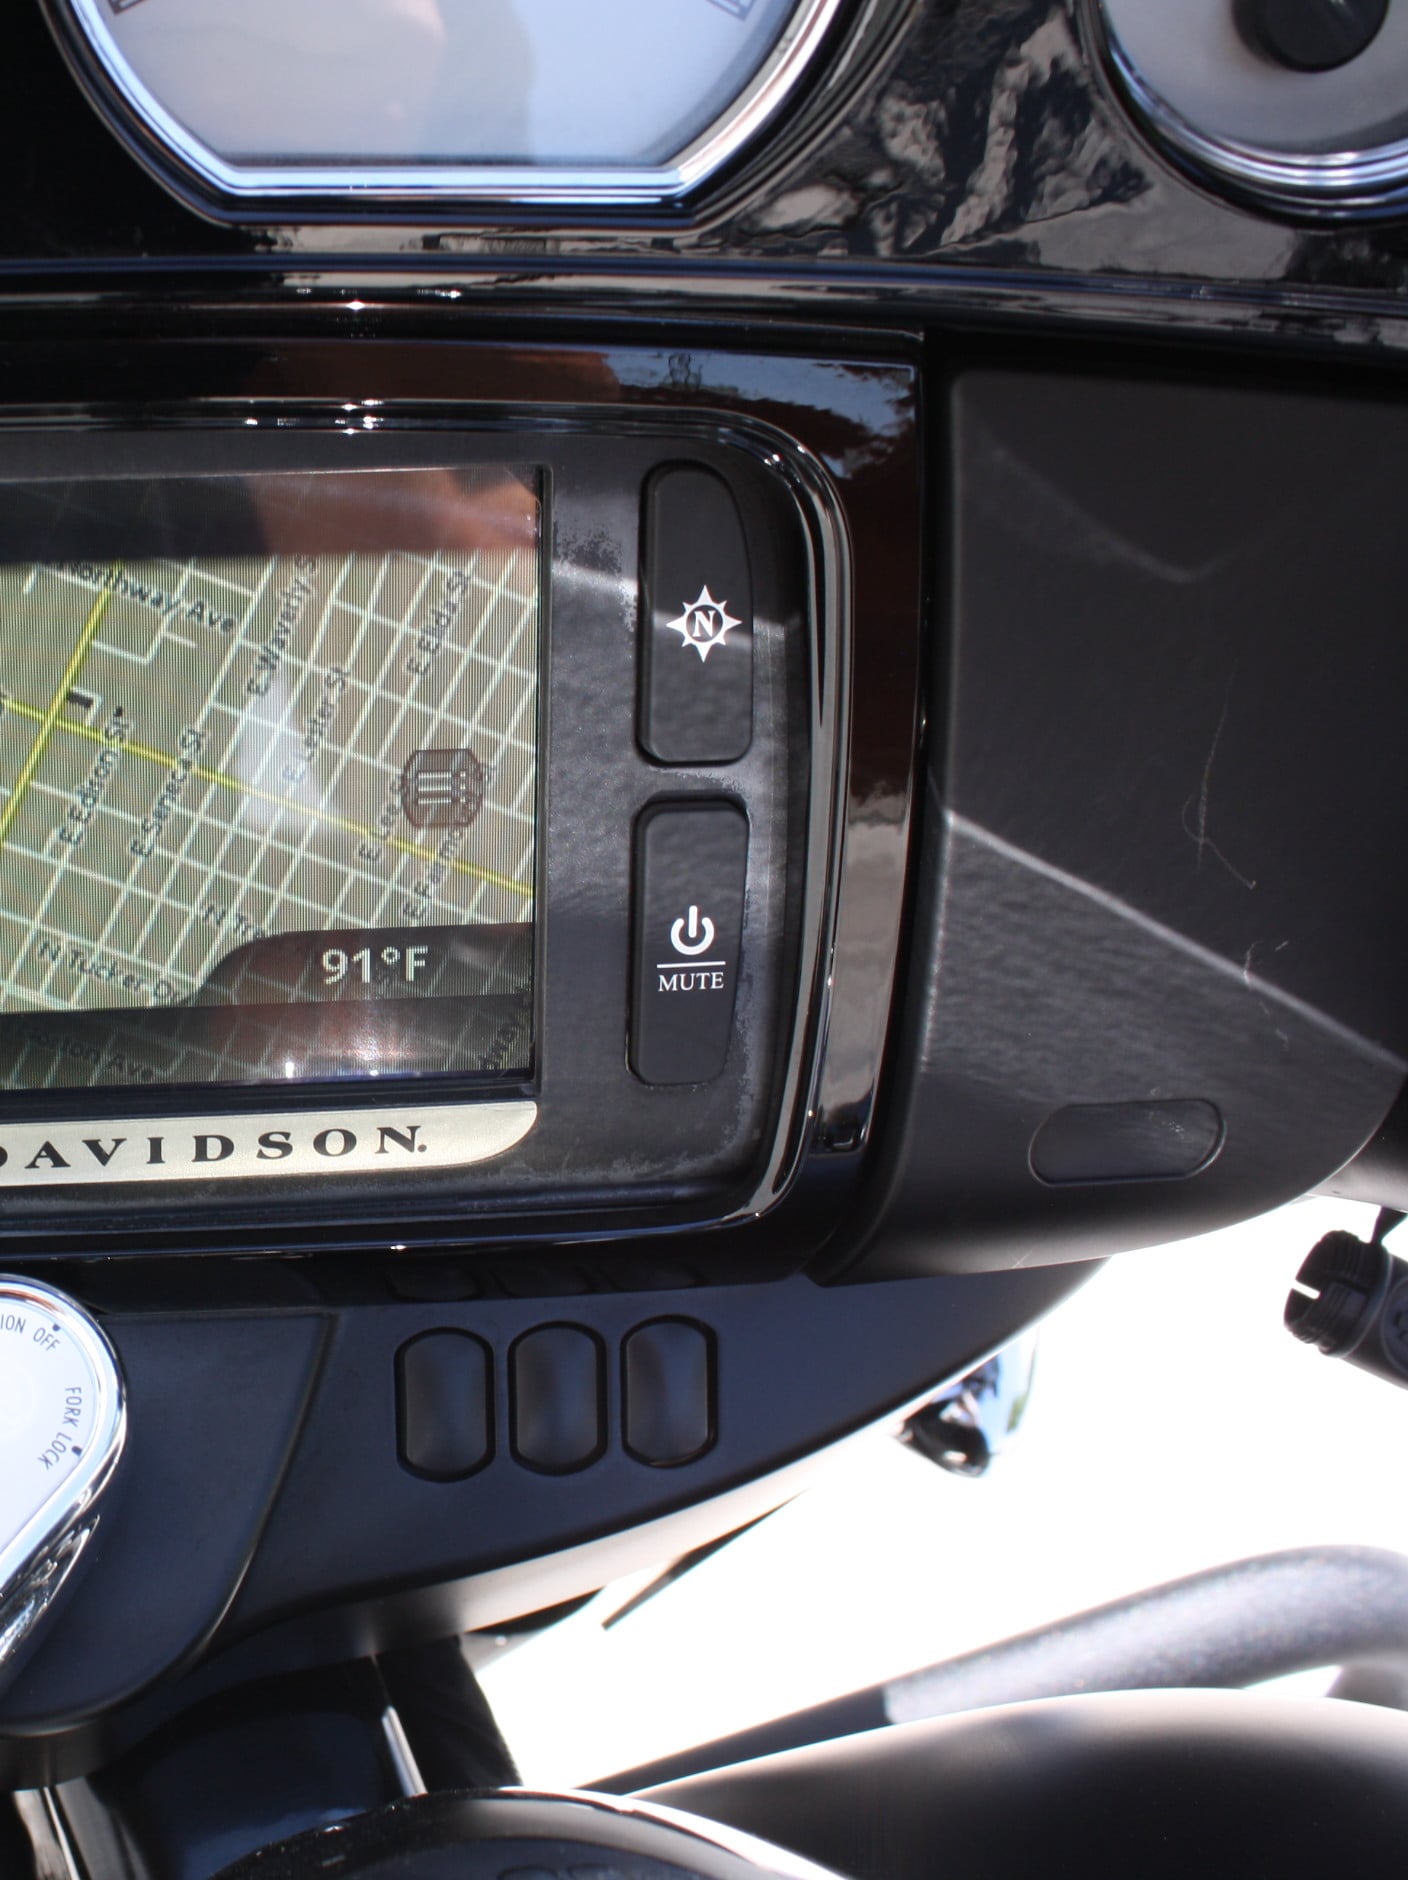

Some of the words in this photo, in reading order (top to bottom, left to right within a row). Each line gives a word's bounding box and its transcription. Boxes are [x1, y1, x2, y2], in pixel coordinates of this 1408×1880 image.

[187, 599, 237, 634] Ave
[406, 656, 430, 676] E
[446, 569, 471, 595] St
[247, 677, 270, 697] E
[324, 666, 351, 690] St
[131, 836, 154, 858] E
[179, 727, 205, 753] St
[59, 826, 83, 846] E
[68, 950, 147, 992] Tucker
[321, 944, 430, 986] 91°F
[657, 971, 724, 992] MUTE
[32, 1327, 61, 1352] OFF
[62, 1386, 83, 1428] FORK
[37, 1431, 73, 1470] LOCK
